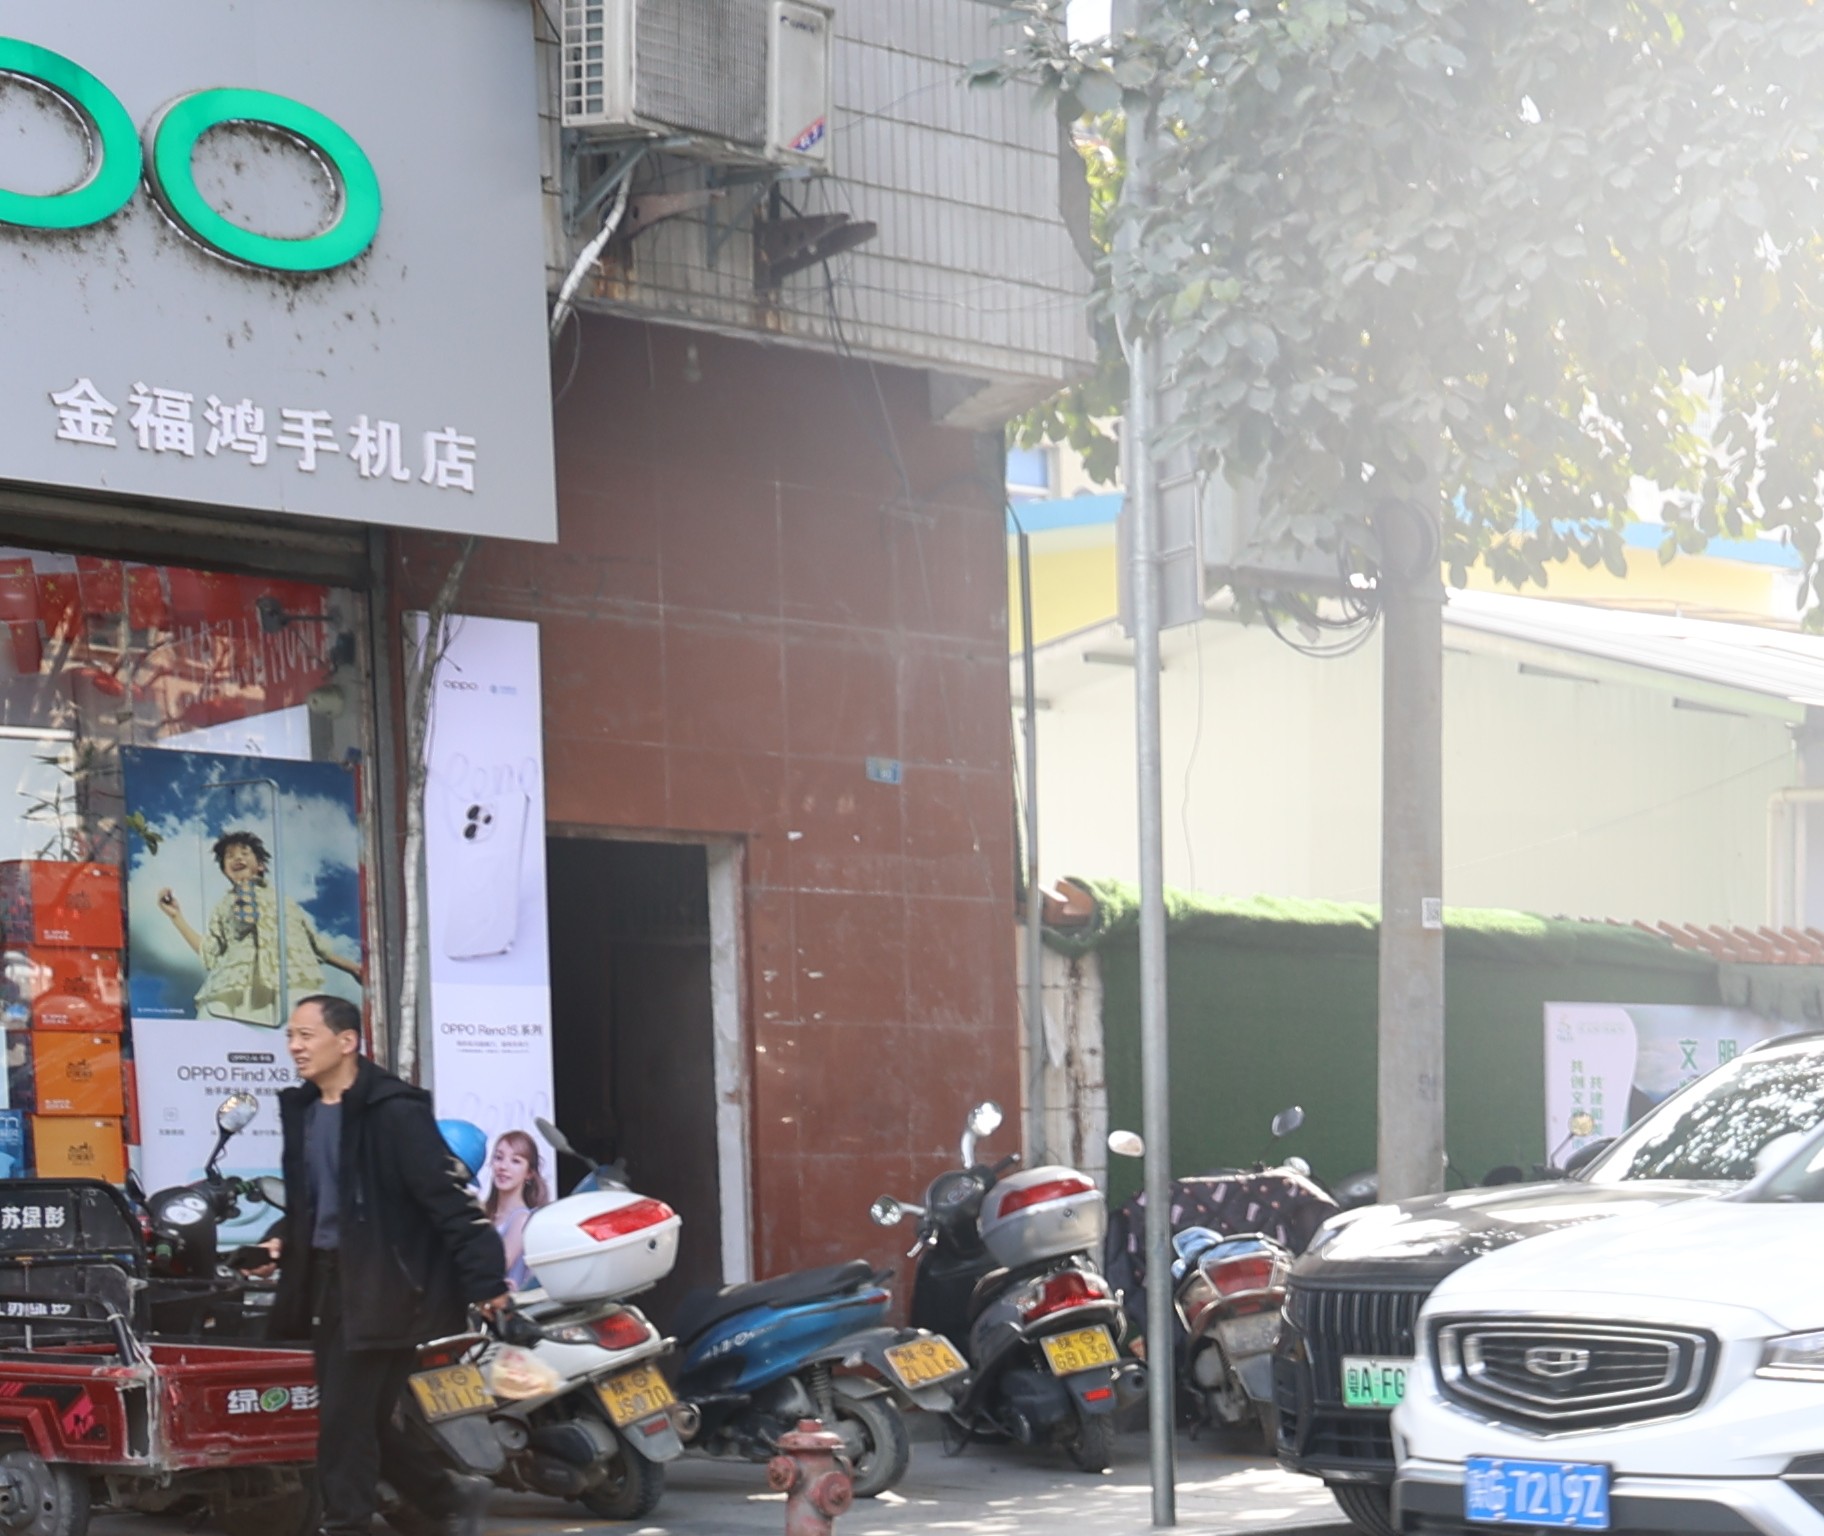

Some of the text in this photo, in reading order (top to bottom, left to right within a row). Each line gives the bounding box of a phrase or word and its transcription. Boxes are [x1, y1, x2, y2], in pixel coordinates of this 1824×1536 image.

[50, 377, 477, 493] 金福鸿手机店
[177, 1066, 227, 1082] OPPO
[231, 1067, 265, 1082] Find
[268, 1068, 290, 1082] X8
